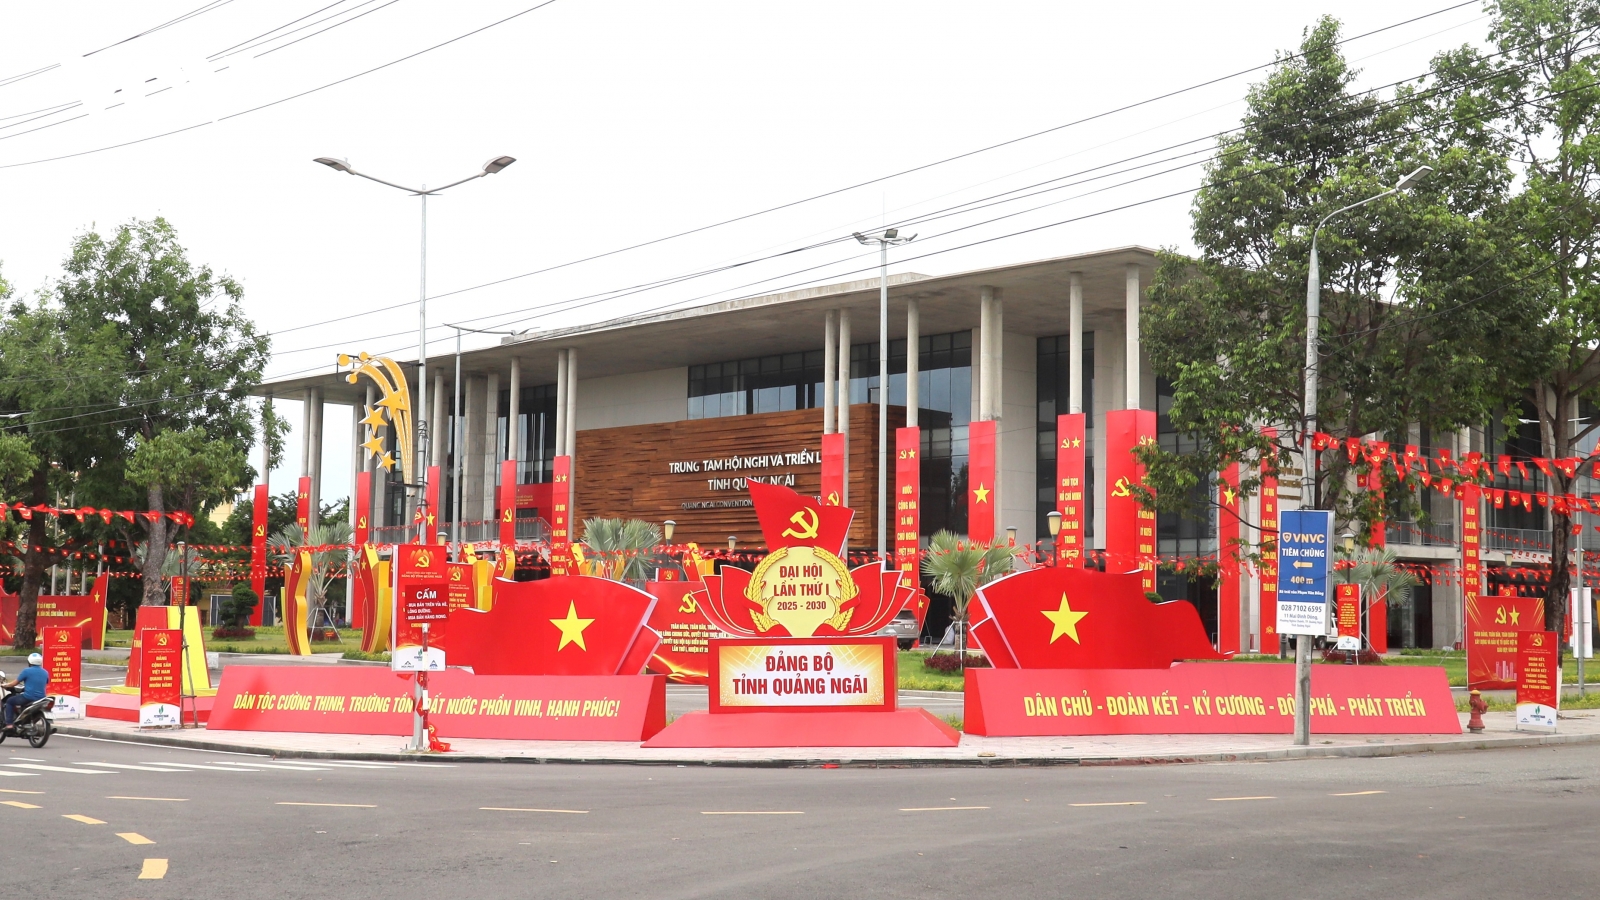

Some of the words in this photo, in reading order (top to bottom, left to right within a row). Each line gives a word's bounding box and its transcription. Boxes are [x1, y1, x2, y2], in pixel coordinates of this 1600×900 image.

[669, 462, 699, 473] TRUNG
[725, 456, 741, 471] HỘI
[744, 456, 768, 470] NGHỊ
[785, 448, 813, 465] TRIỂN
[1293, 533, 1325, 543] VNVC
[1282, 547, 1299, 556] TIÊM
[780, 565, 799, 580] ĐẠI
[803, 563, 822, 580] HỘI
[416, 588, 436, 599] CẤM
[774, 580, 796, 596] LẦN
[800, 583, 823, 596] THỨ
[826, 584, 829, 595] I
[777, 602, 798, 610] 2025
[806, 601, 826, 610] 2030
[766, 650, 808, 672] ĐẢNG
[814, 652, 833, 674] BỘ
[733, 673, 767, 694] TỈNH
[773, 673, 825, 696] QUẢNG
[831, 674, 867, 693] NGÃI
[233, 691, 254, 710] DÂN
[257, 692, 276, 713] TỘC
[277, 691, 311, 710] CƯỜNG
[313, 696, 345, 714] THỊNH,
[349, 693, 390, 712] TRƯỜNG
[446, 696, 477, 715] NƯỚC
[479, 694, 511, 715] PHỒN
[513, 700, 543, 718] VINH,
[546, 699, 581, 720] HẠNH
[582, 697, 620, 717] PHÚC!
[1024, 693, 1058, 716] DÂN
[1061, 690, 1093, 716] CHỦ
[1106, 692, 1149, 715] ĐOÀN
[1151, 690, 1179, 715] KẾT
[1192, 690, 1211, 715] KỶ
[1216, 694, 1266, 715] CƯƠNG
[1277, 693, 1296, 719] ĐỘ
[1310, 694, 1338, 716] PHÁ
[1348, 694, 1384, 716] PHÁT
[1385, 691, 1426, 716] TRIỂN
